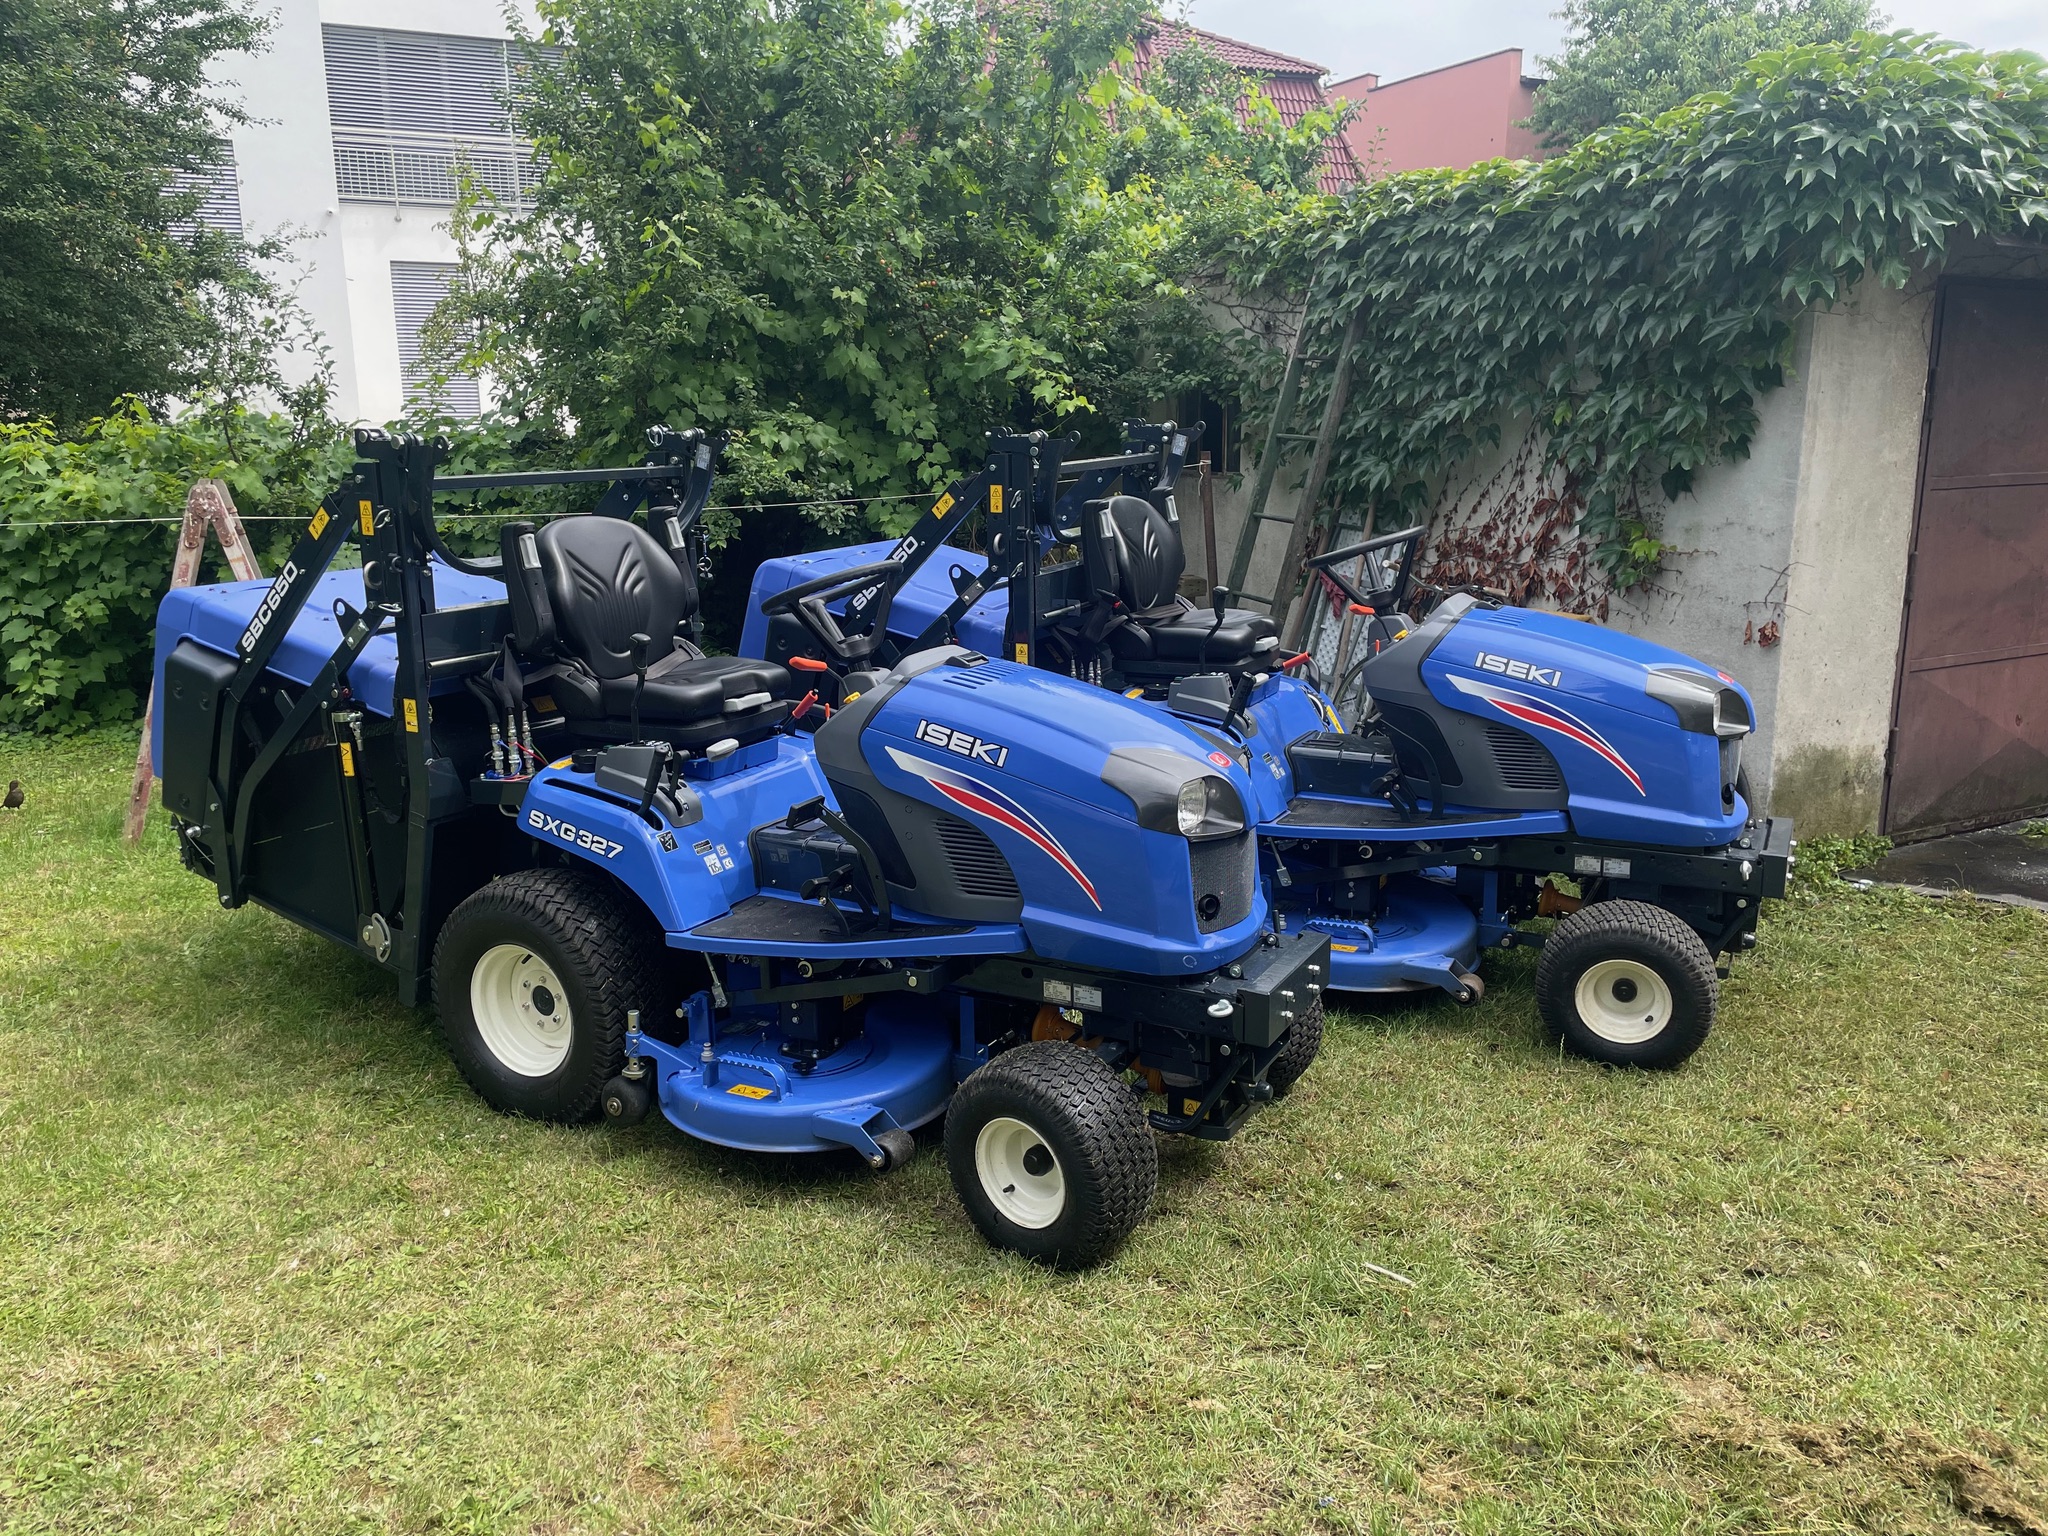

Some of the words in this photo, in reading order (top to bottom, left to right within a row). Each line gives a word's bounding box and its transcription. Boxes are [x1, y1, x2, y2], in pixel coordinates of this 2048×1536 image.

[852, 535, 919, 611] SB50
[241, 560, 298, 653] SBC650
[1474, 651, 1562, 688] ISEKI
[915, 719, 1009, 768] ISEKI
[528, 809, 624, 860] SXG327
